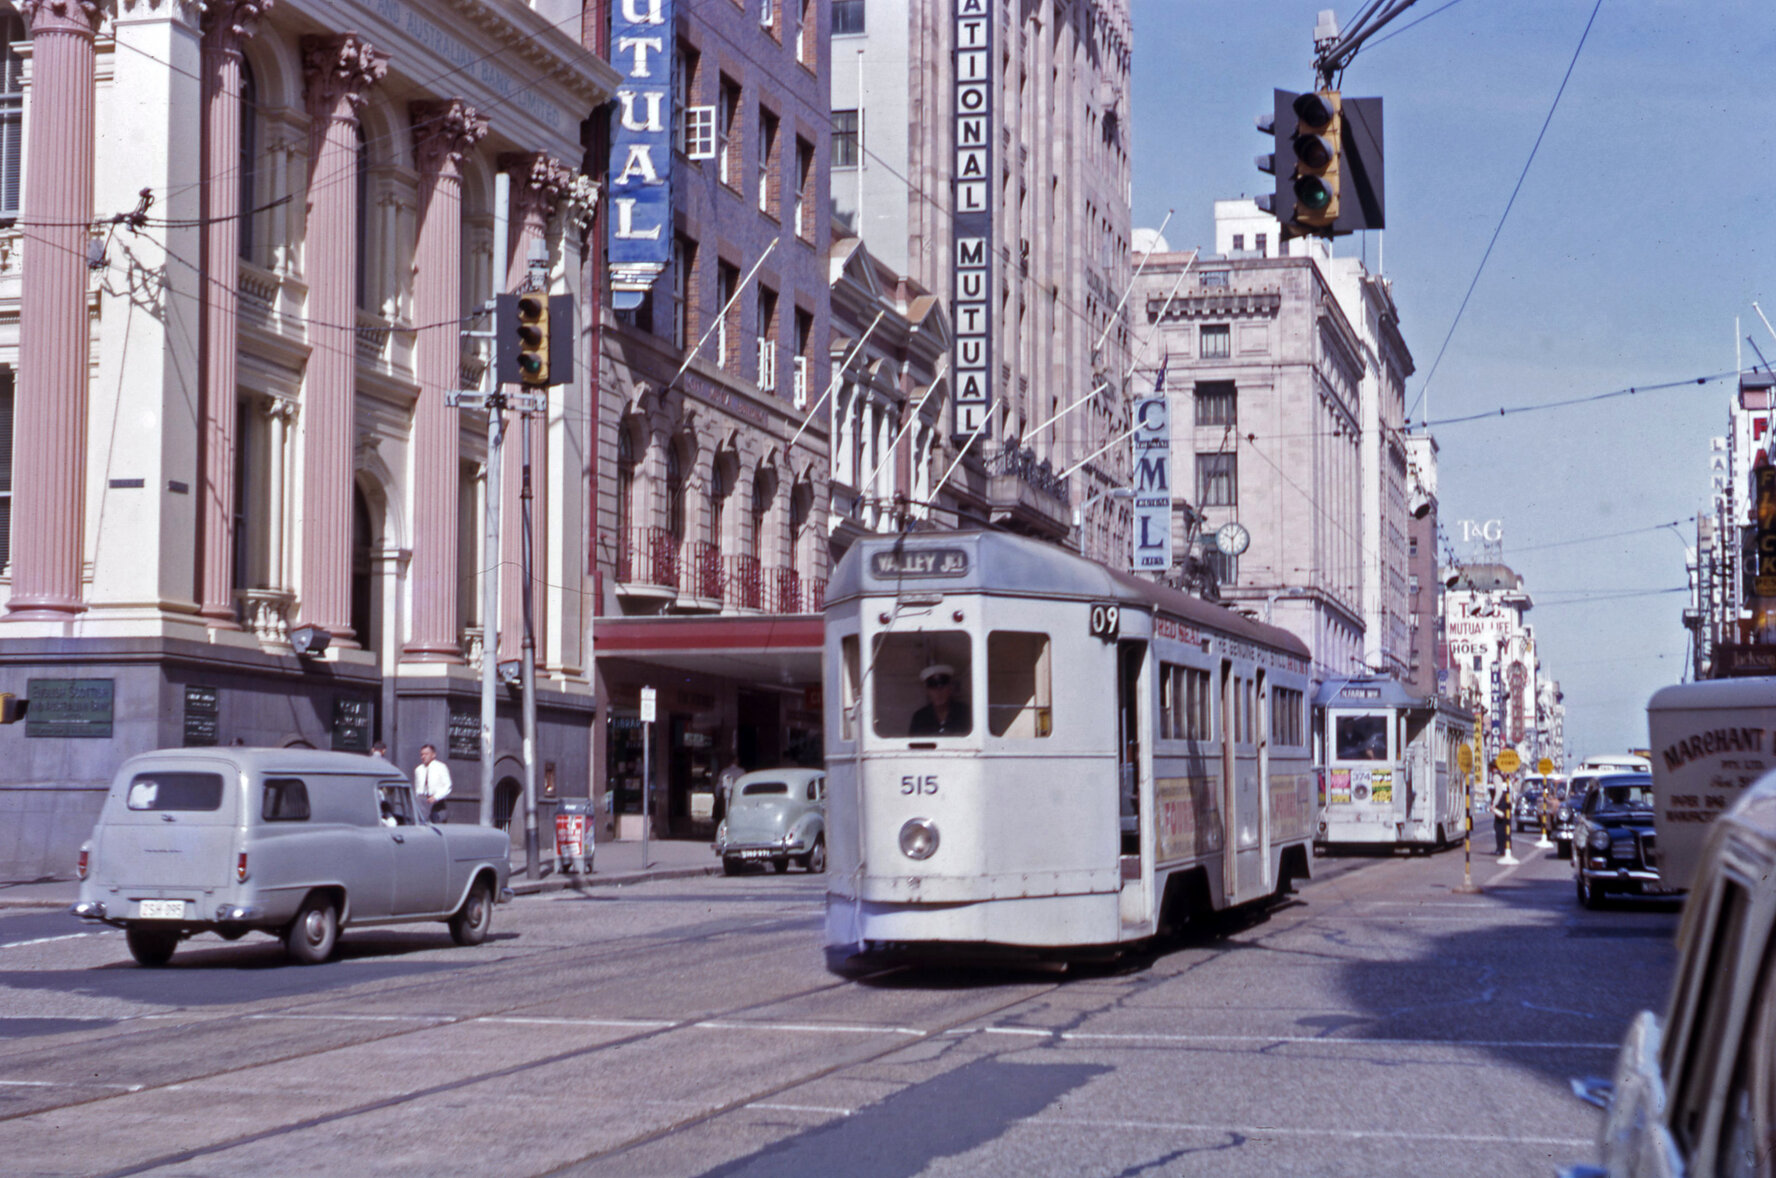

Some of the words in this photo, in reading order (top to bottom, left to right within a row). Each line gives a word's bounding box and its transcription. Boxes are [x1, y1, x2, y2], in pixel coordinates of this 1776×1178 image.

[960, 240, 983, 433] MUTUAL
[1092, 605, 1119, 634] 09
[1157, 617, 1177, 639] RED
[1178, 622, 1202, 647] SEAL
[613, 717, 641, 729] LIBRAR
[900, 775, 940, 796] 515
